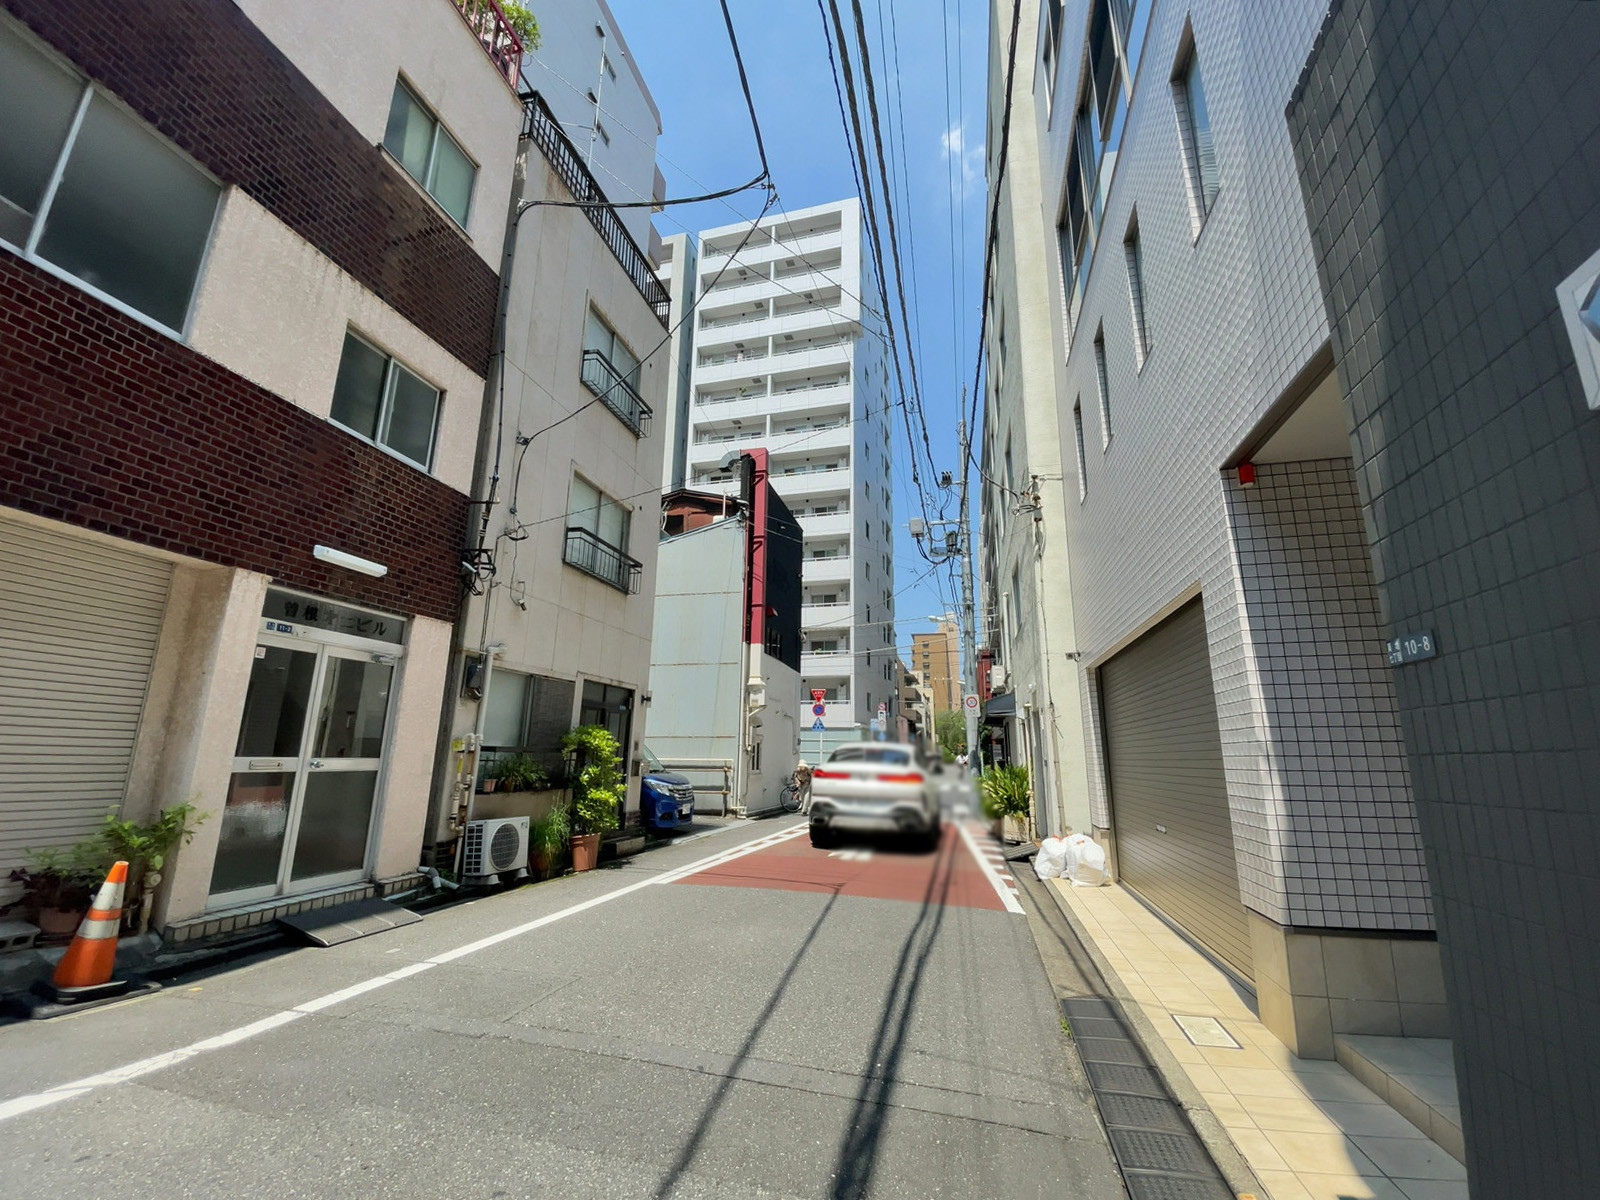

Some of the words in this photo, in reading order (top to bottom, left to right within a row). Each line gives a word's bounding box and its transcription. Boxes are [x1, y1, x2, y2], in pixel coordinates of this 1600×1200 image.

[284, 601, 388, 636] 曽根二ビル
[1404, 635, 1431, 656] 10-8
